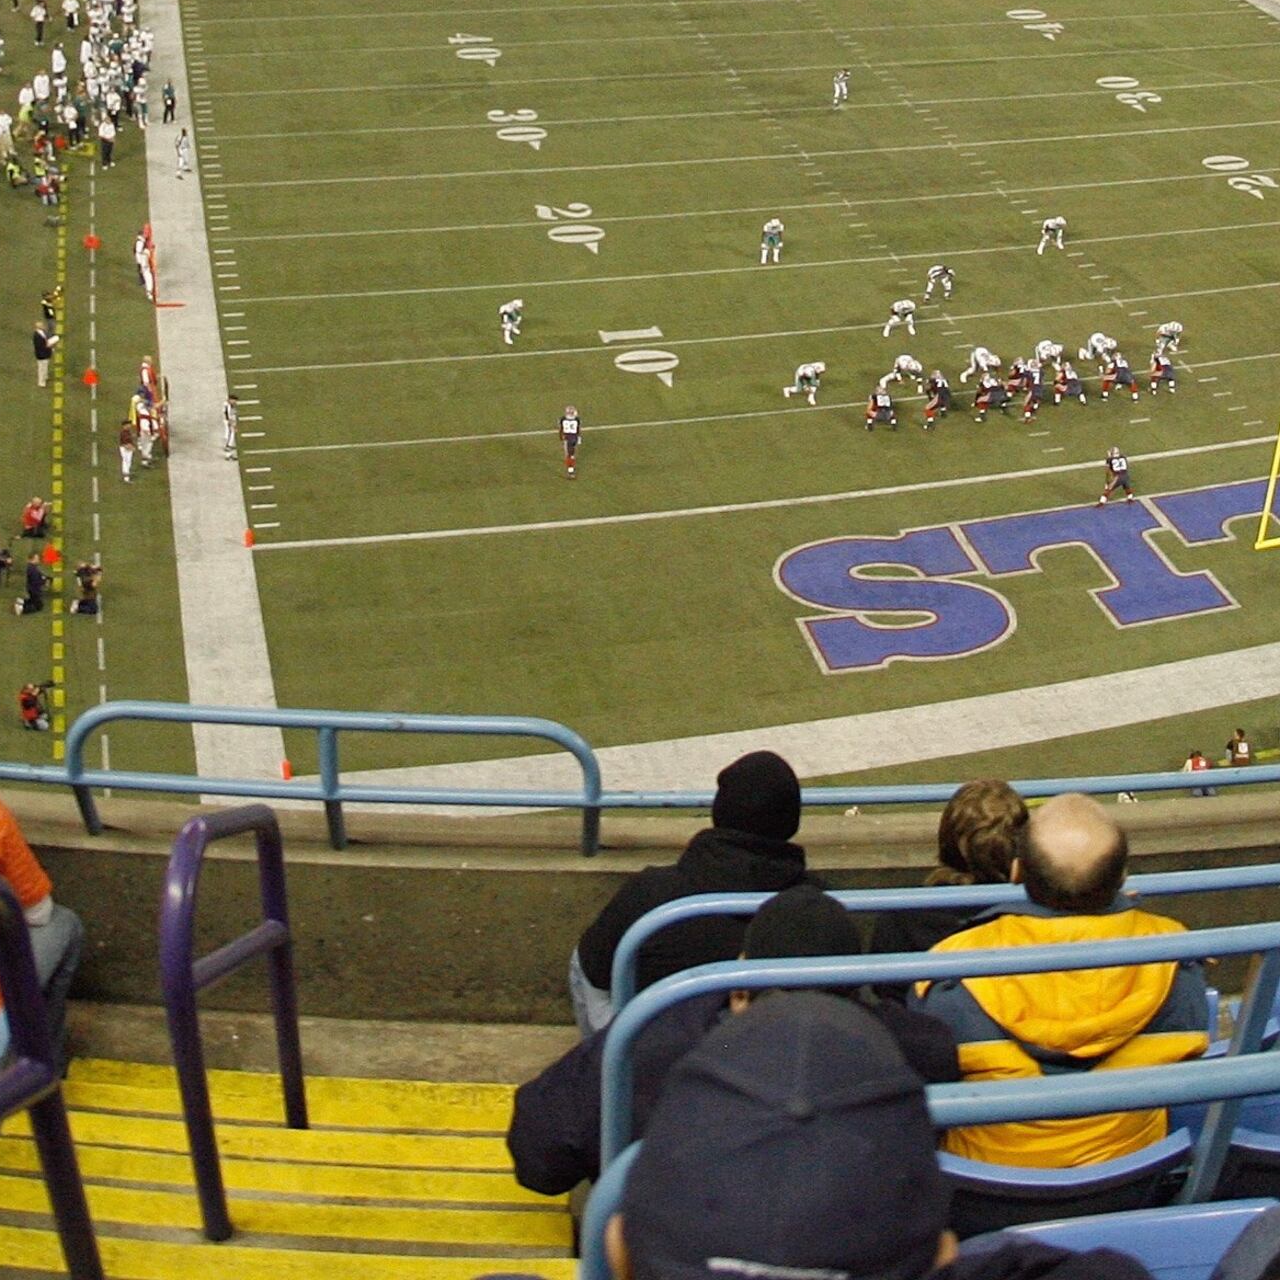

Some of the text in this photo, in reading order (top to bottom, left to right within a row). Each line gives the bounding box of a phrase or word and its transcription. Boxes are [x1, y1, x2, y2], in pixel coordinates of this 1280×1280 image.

[1006, 9, 1065, 35] 40
[448, 33, 502, 60] 40
[1096, 76, 1162, 105] 30
[487, 109, 548, 141] 30
[1202, 155, 1280, 193] 20
[535, 202, 605, 243] 20
[598, 325, 680, 374] 10
